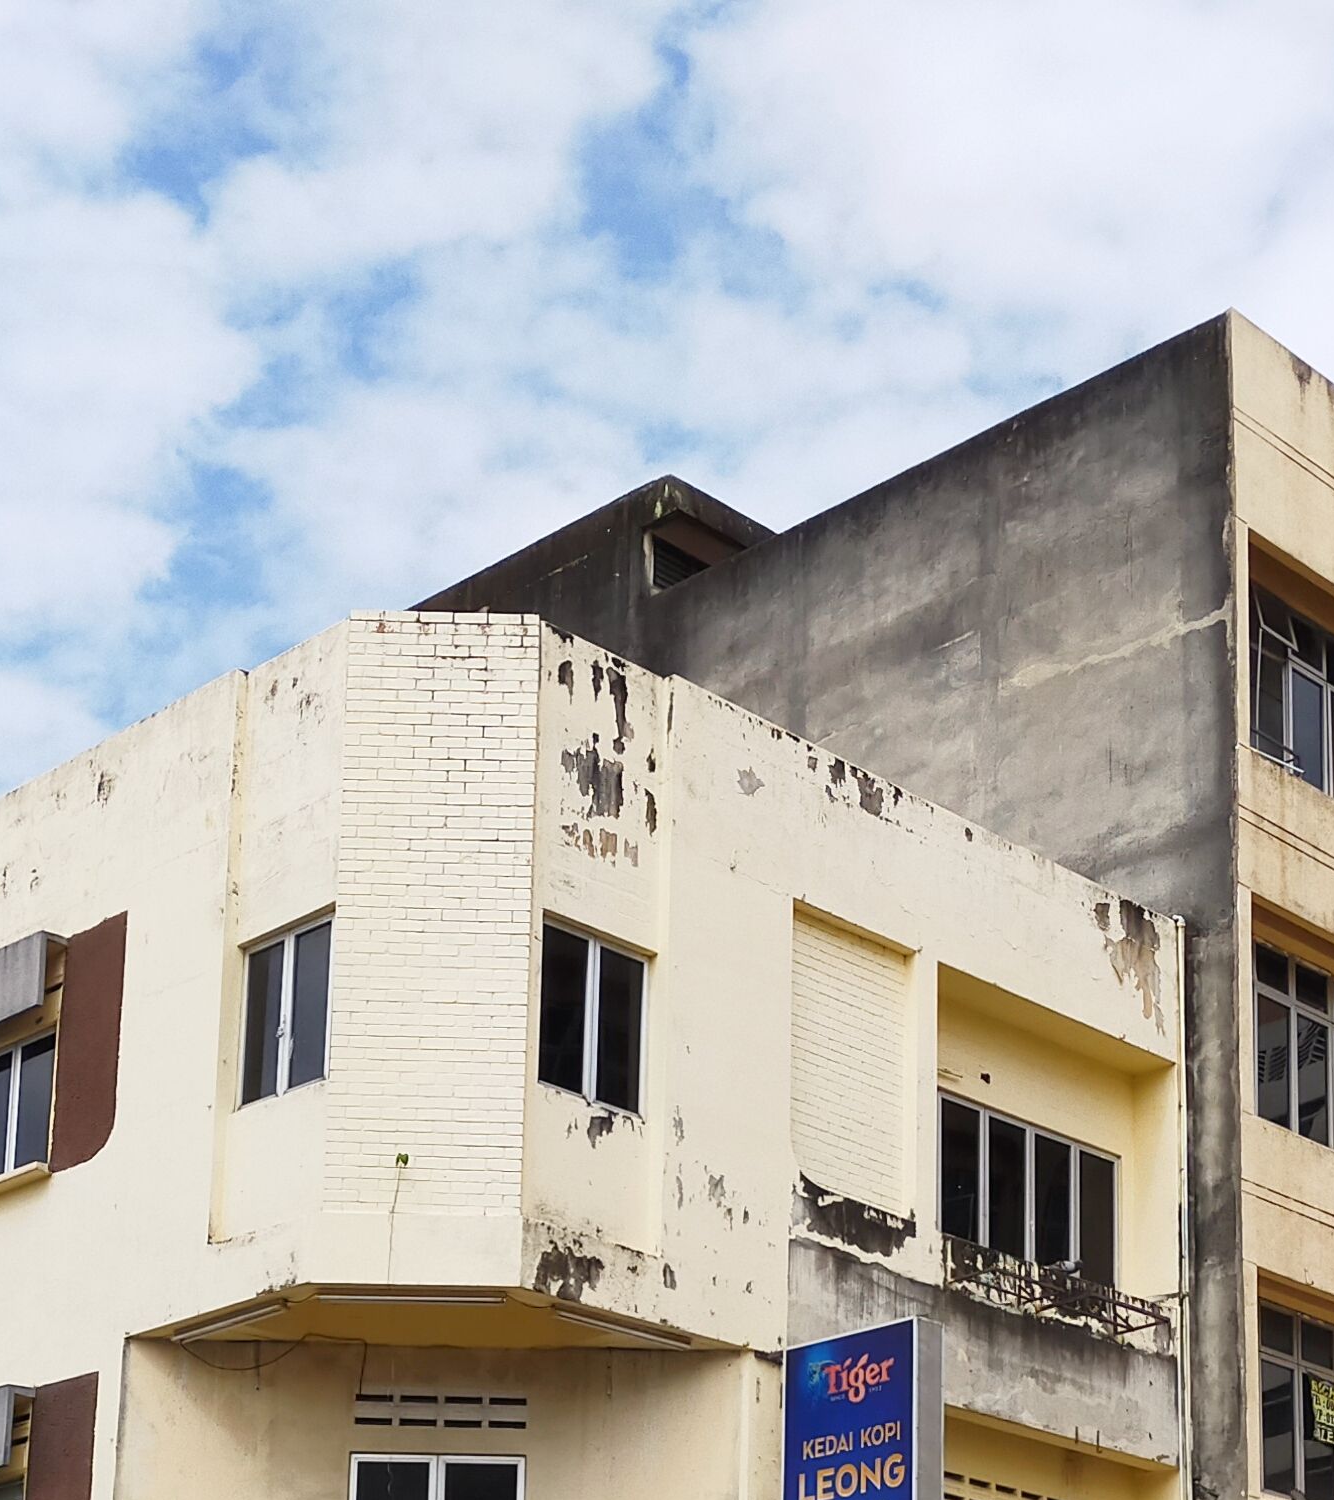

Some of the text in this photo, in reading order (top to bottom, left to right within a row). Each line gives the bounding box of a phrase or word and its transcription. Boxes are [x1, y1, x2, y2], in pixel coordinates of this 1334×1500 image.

[822, 1353, 895, 1403] Tiger
[802, 1420, 901, 1461] KEDAI KOPI
